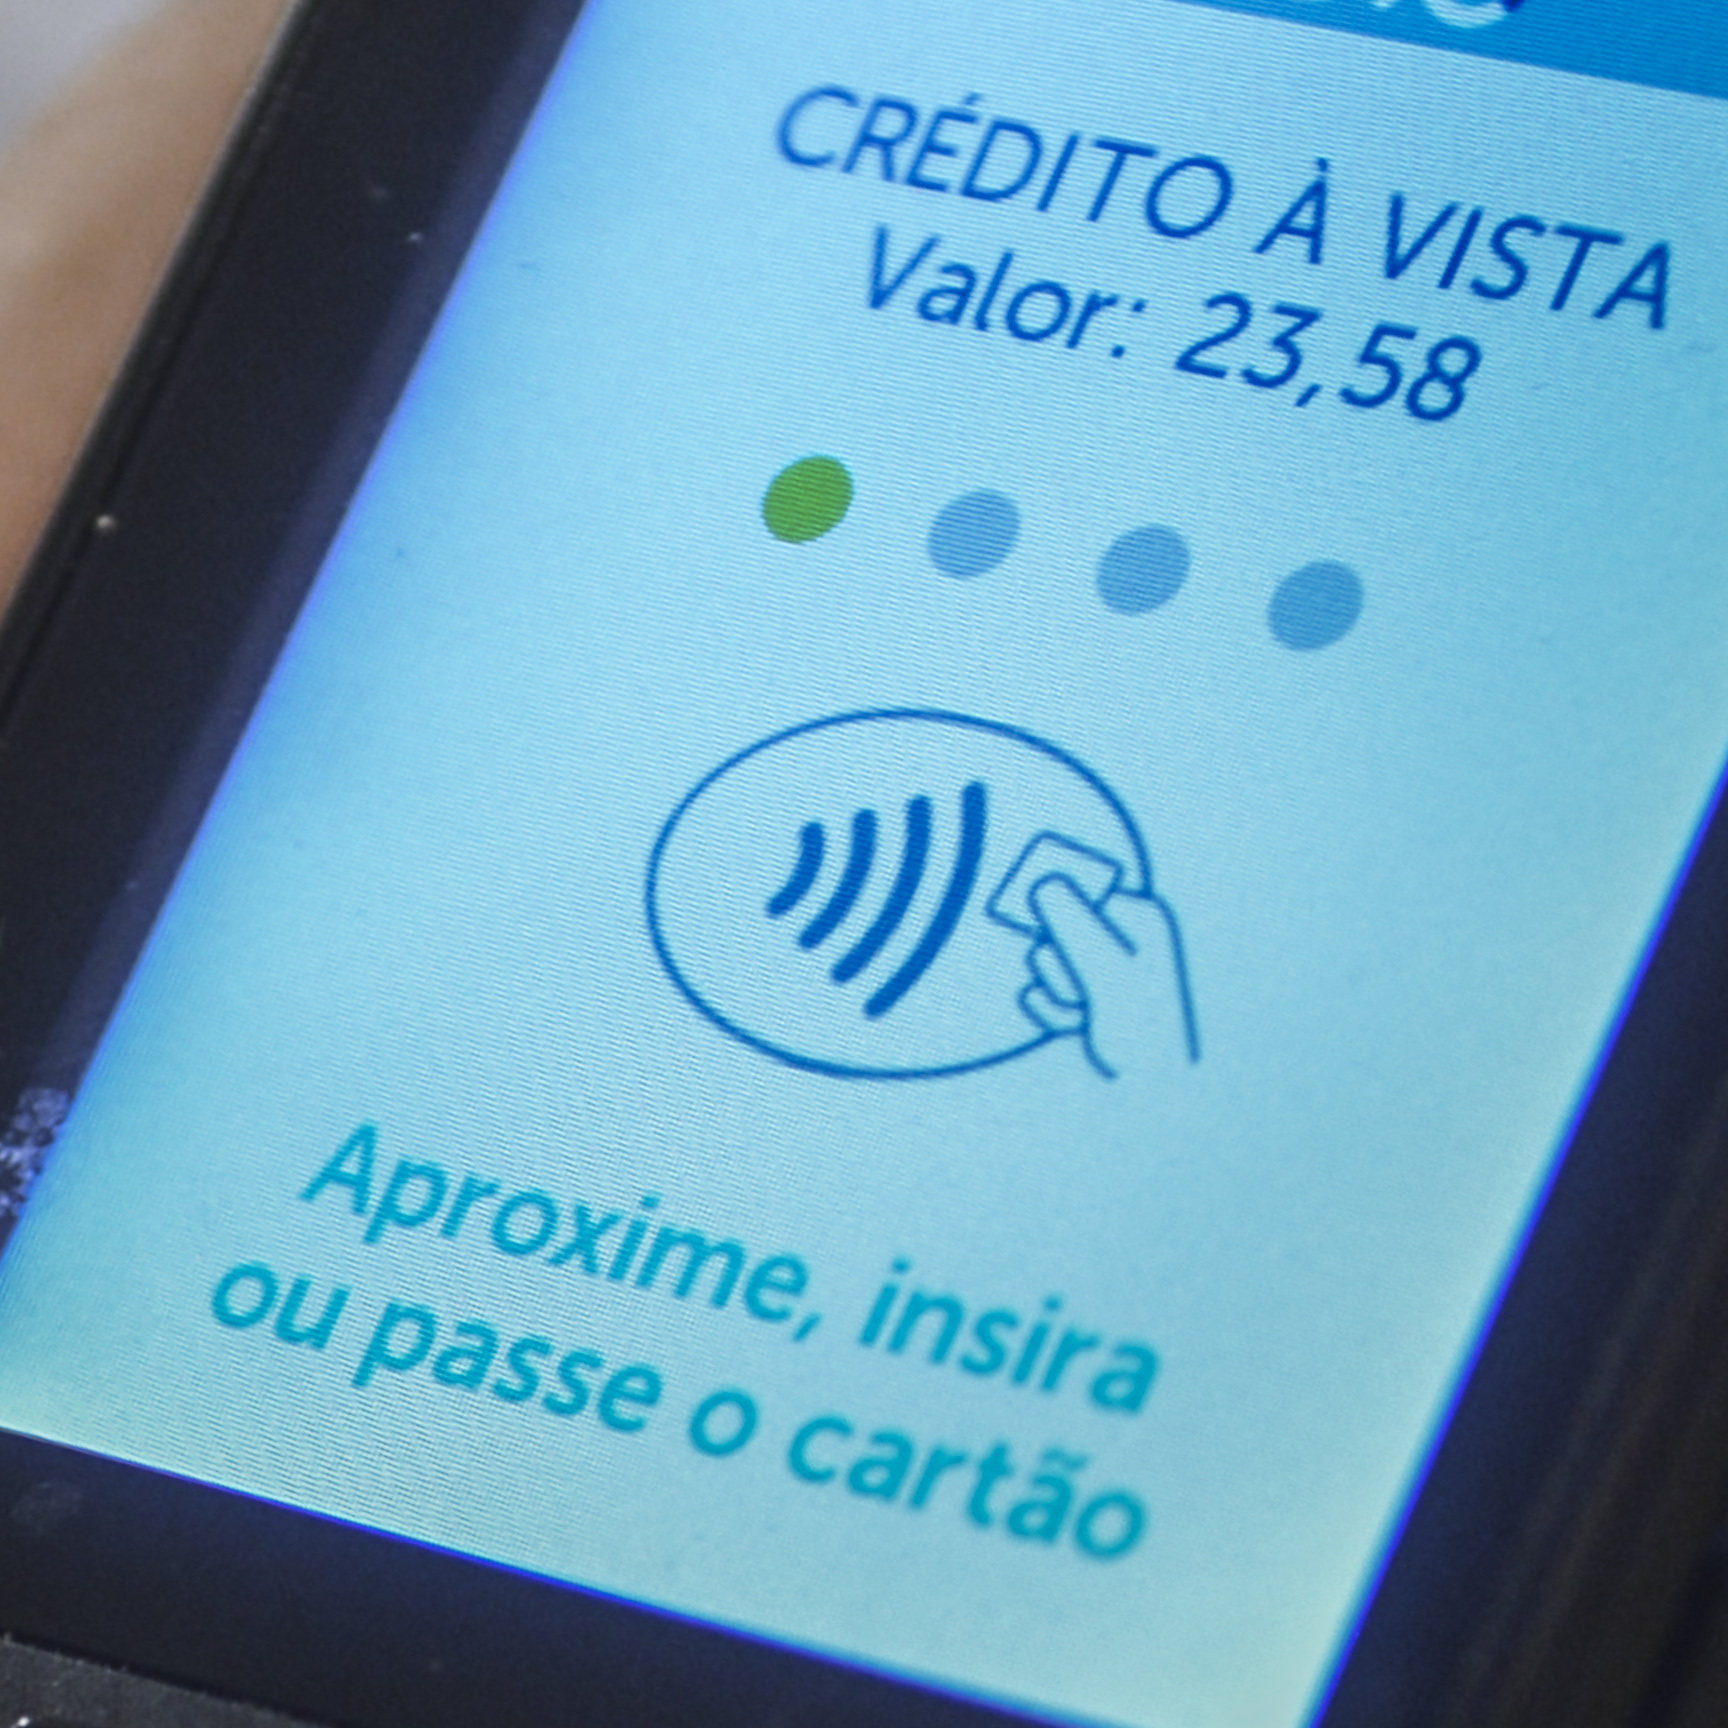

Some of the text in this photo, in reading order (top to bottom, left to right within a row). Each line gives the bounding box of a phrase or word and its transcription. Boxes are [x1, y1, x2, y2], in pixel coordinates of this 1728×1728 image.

[774, 86, 1675, 332] CRÉDITO À VISTA
[863, 225, 1484, 425] Valor: 23,58
[300, 1122, 1162, 1416] Aproxime, insira
[210, 1258, 1148, 1562] ou passe o cartão
